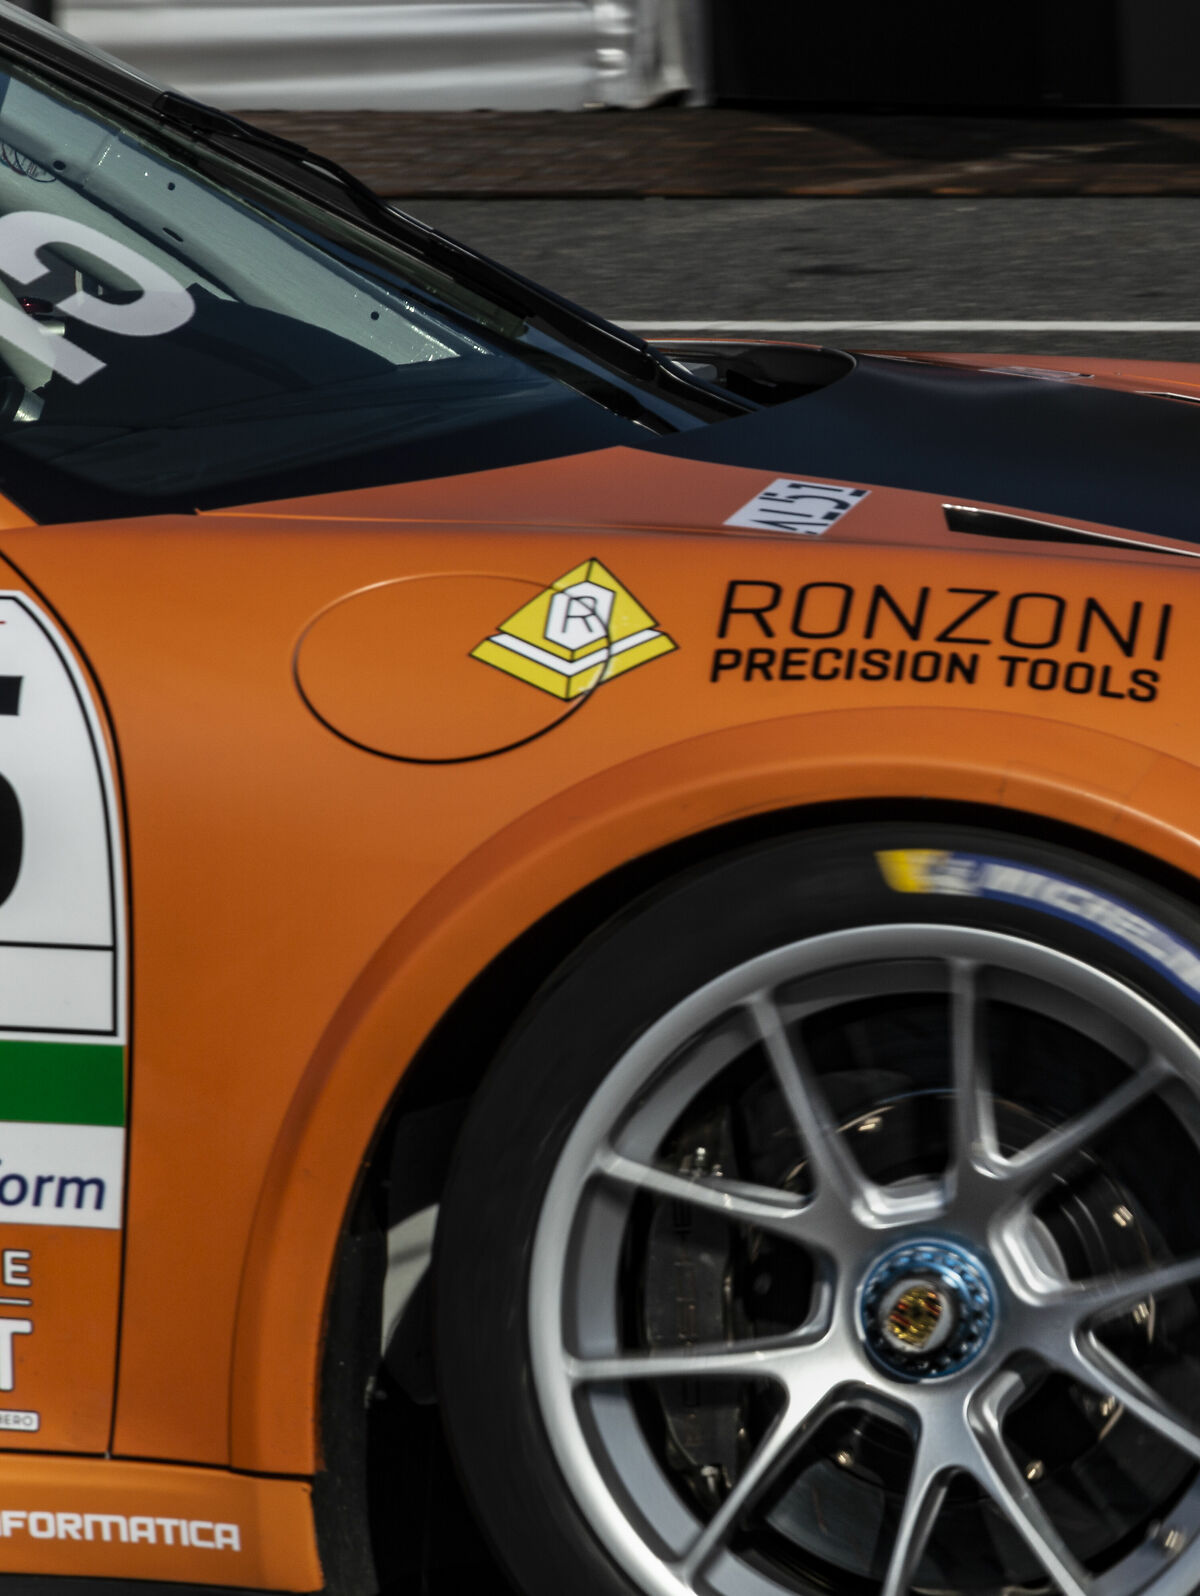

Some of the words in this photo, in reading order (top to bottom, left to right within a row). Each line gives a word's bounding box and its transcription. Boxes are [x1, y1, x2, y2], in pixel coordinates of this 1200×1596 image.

[562, 595, 598, 634] R
[716, 578, 1173, 662] RONZONI
[709, 646, 980, 686] PRECISION
[997, 654, 1161, 704] TOOLS
[0, 1172, 106, 1211] orm
[0, 1510, 242, 1552] FORMATICA
